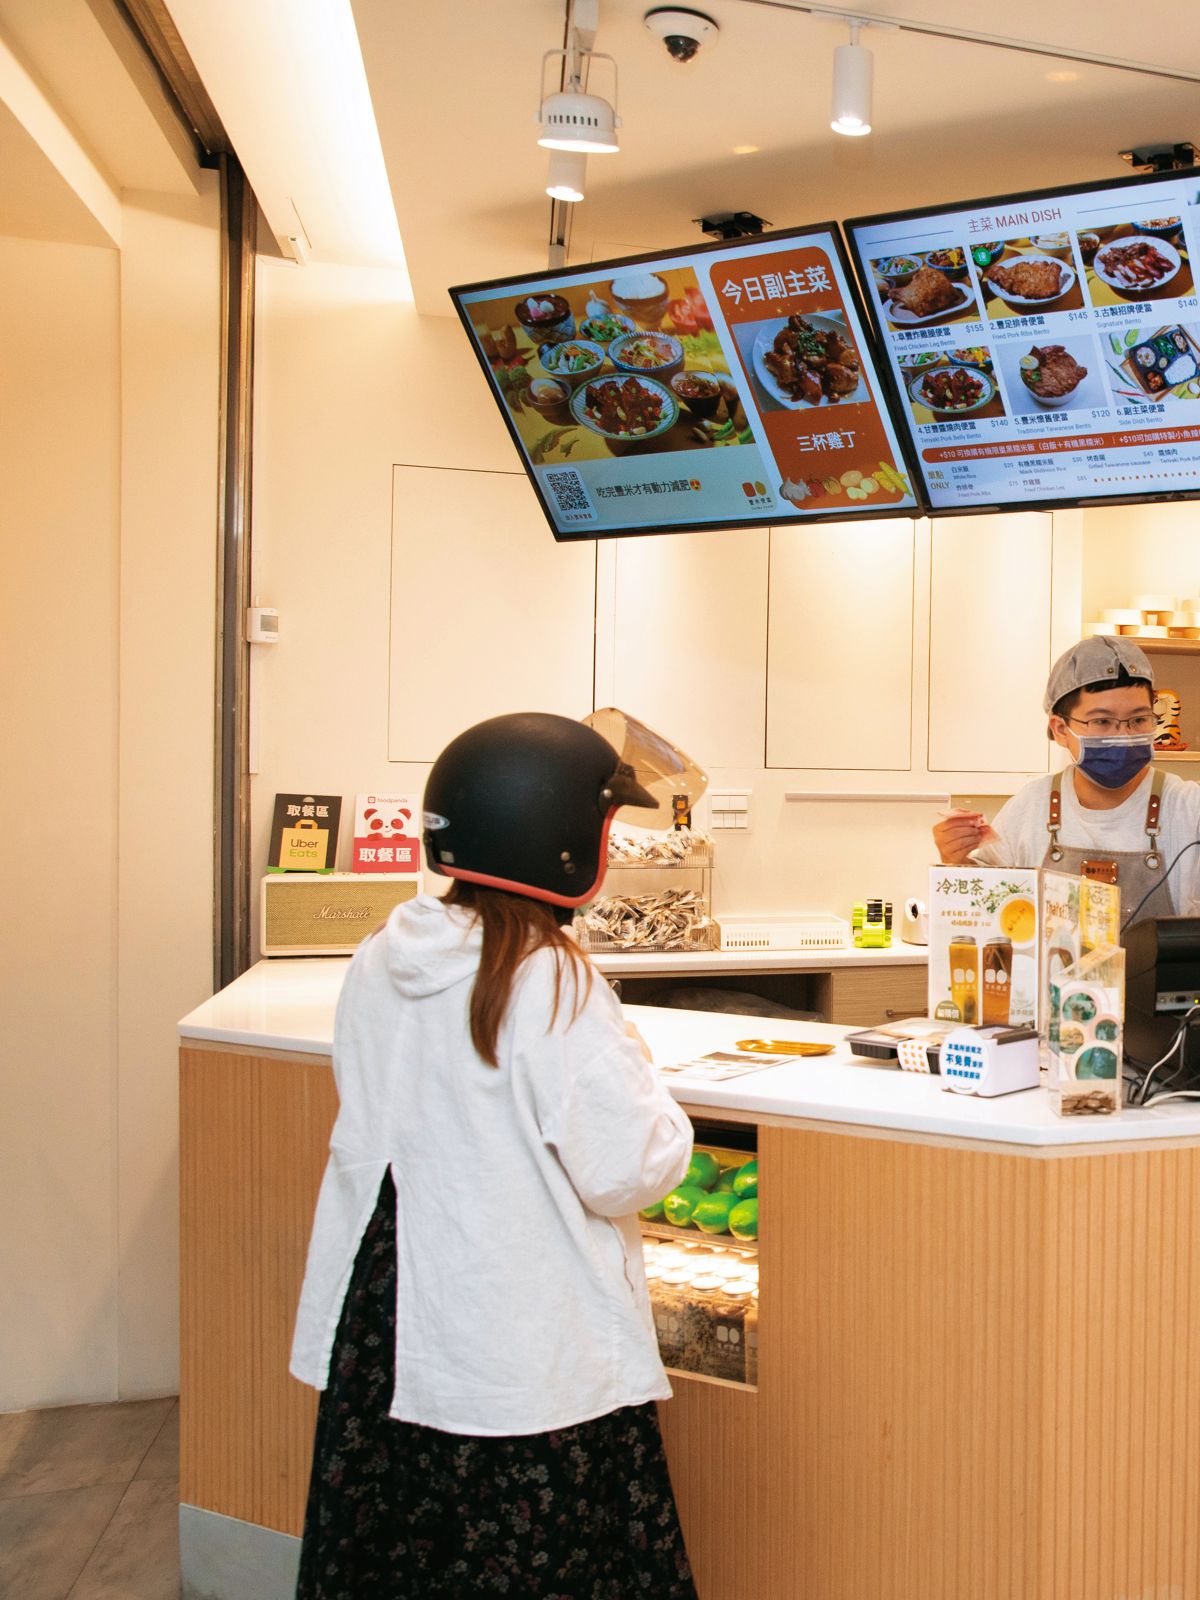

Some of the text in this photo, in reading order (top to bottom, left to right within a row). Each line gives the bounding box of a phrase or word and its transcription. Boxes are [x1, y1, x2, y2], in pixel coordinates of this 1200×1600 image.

[968, 207, 1062, 233] 主菜 MAIN DISH
[721, 264, 833, 305] 今日副主菜
[1177, 299, 1198, 309] $140
[1068, 311, 1088, 321] $145
[965, 323, 985, 334] $155
[1091, 409, 1111, 419] $120
[990, 418, 1009, 428] $140
[796, 430, 856, 453] 三杯雞丁
[596, 479, 690, 499] 吃完豐米才有動力減肥
[286, 804, 330, 818] 取餐區
[290, 838, 319, 849] Uber
[289, 848, 318, 858] Eats
[359, 847, 412, 862] 取餐區
[936, 878, 984, 895] 冷泡茶
[313, 904, 373, 920] Marshall
